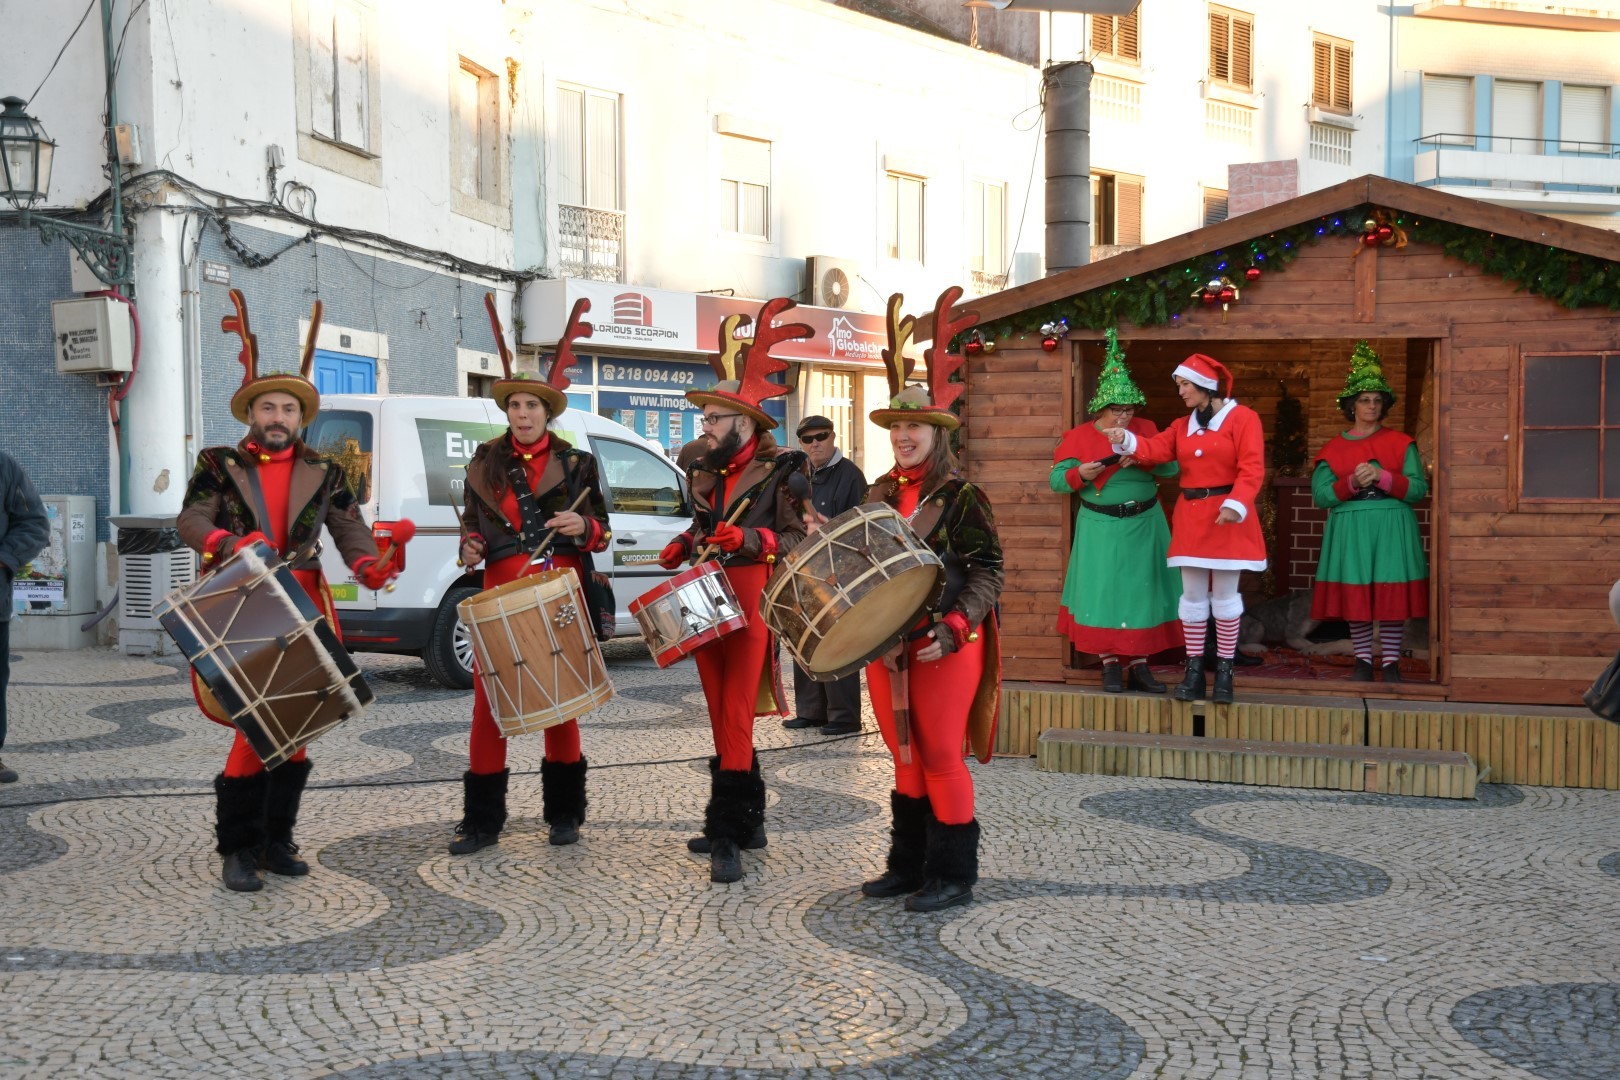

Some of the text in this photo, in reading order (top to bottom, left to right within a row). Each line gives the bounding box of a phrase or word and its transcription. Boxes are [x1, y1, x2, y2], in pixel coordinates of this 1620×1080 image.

[592, 324, 679, 339] LORIOUS SCORPION
[836, 326, 852, 340] Imo
[617, 366, 694, 385] 218 094 492
